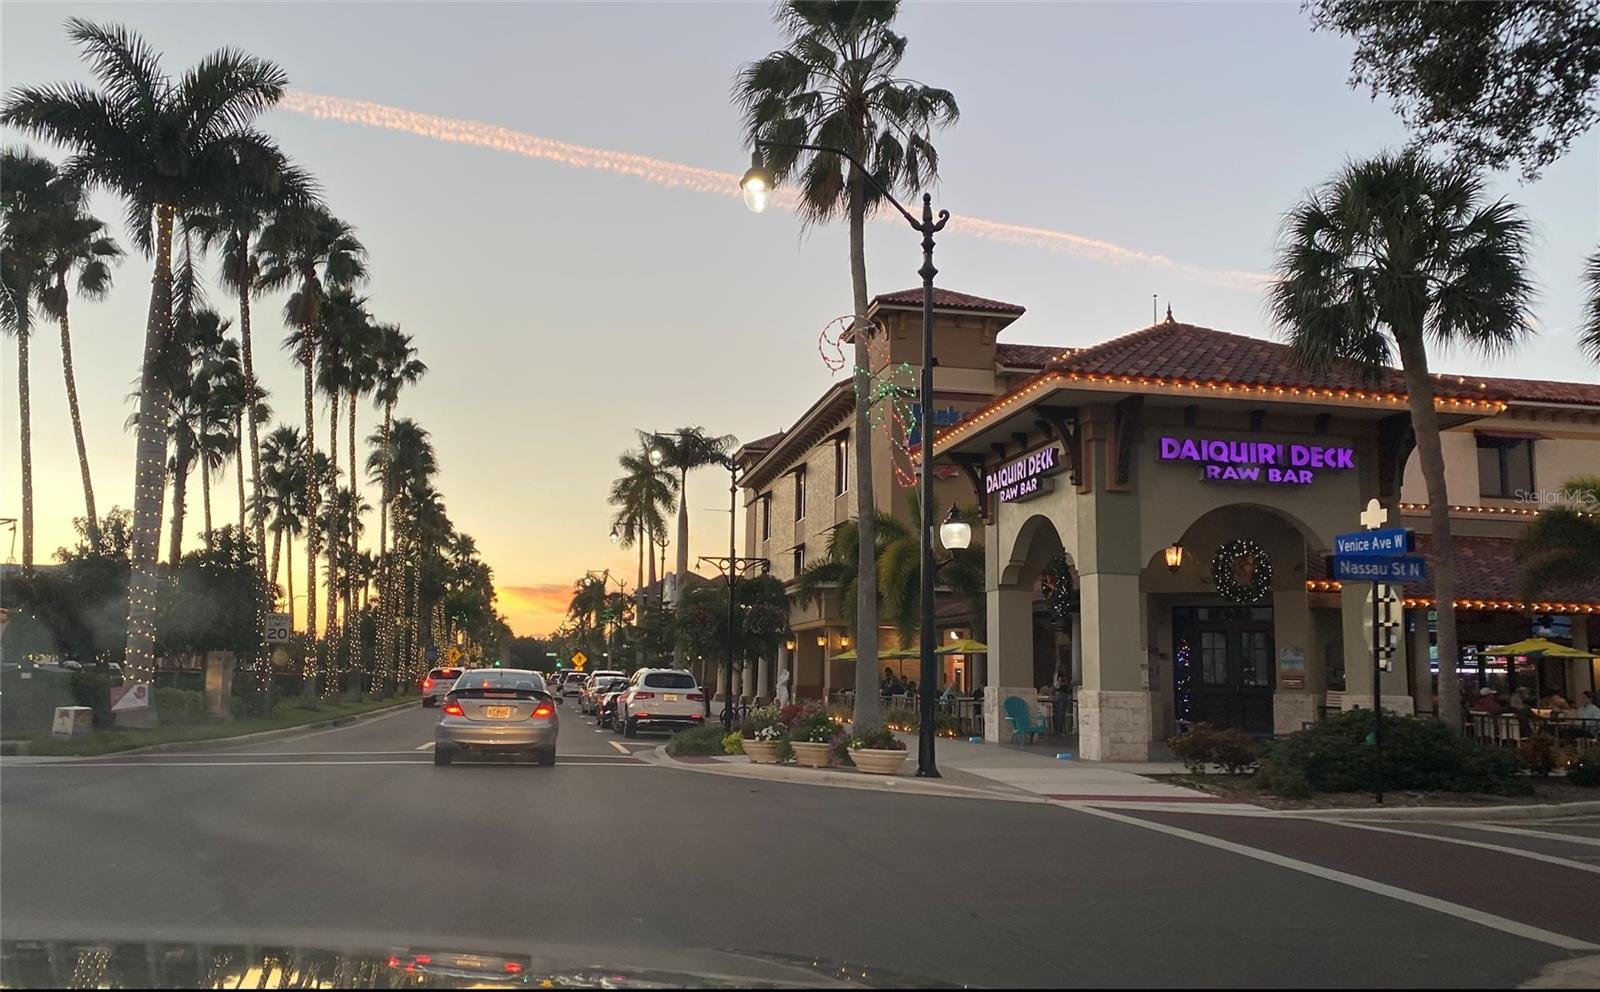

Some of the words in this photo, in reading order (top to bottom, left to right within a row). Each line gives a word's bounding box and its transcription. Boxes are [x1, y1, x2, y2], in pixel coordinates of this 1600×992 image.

[1161, 437, 1284, 464] DAIQUIRI
[1291, 444, 1354, 468] DECK
[986, 459, 1027, 493] DAIQUIRI
[1028, 448, 1053, 476] DECK
[1206, 465, 1260, 481] RAW
[1268, 467, 1313, 484] BAR
[1000, 485, 1018, 502] RAW
[1020, 477, 1037, 495] BAR
[1338, 538, 1369, 552] Venice
[1372, 536, 1391, 550] Ave
[1394, 534, 1403, 548] W
[1341, 561, 1388, 575] Nassau
[1392, 562, 1406, 575] St
[1410, 563, 1419, 576] N
[267, 628, 287, 639] 20
